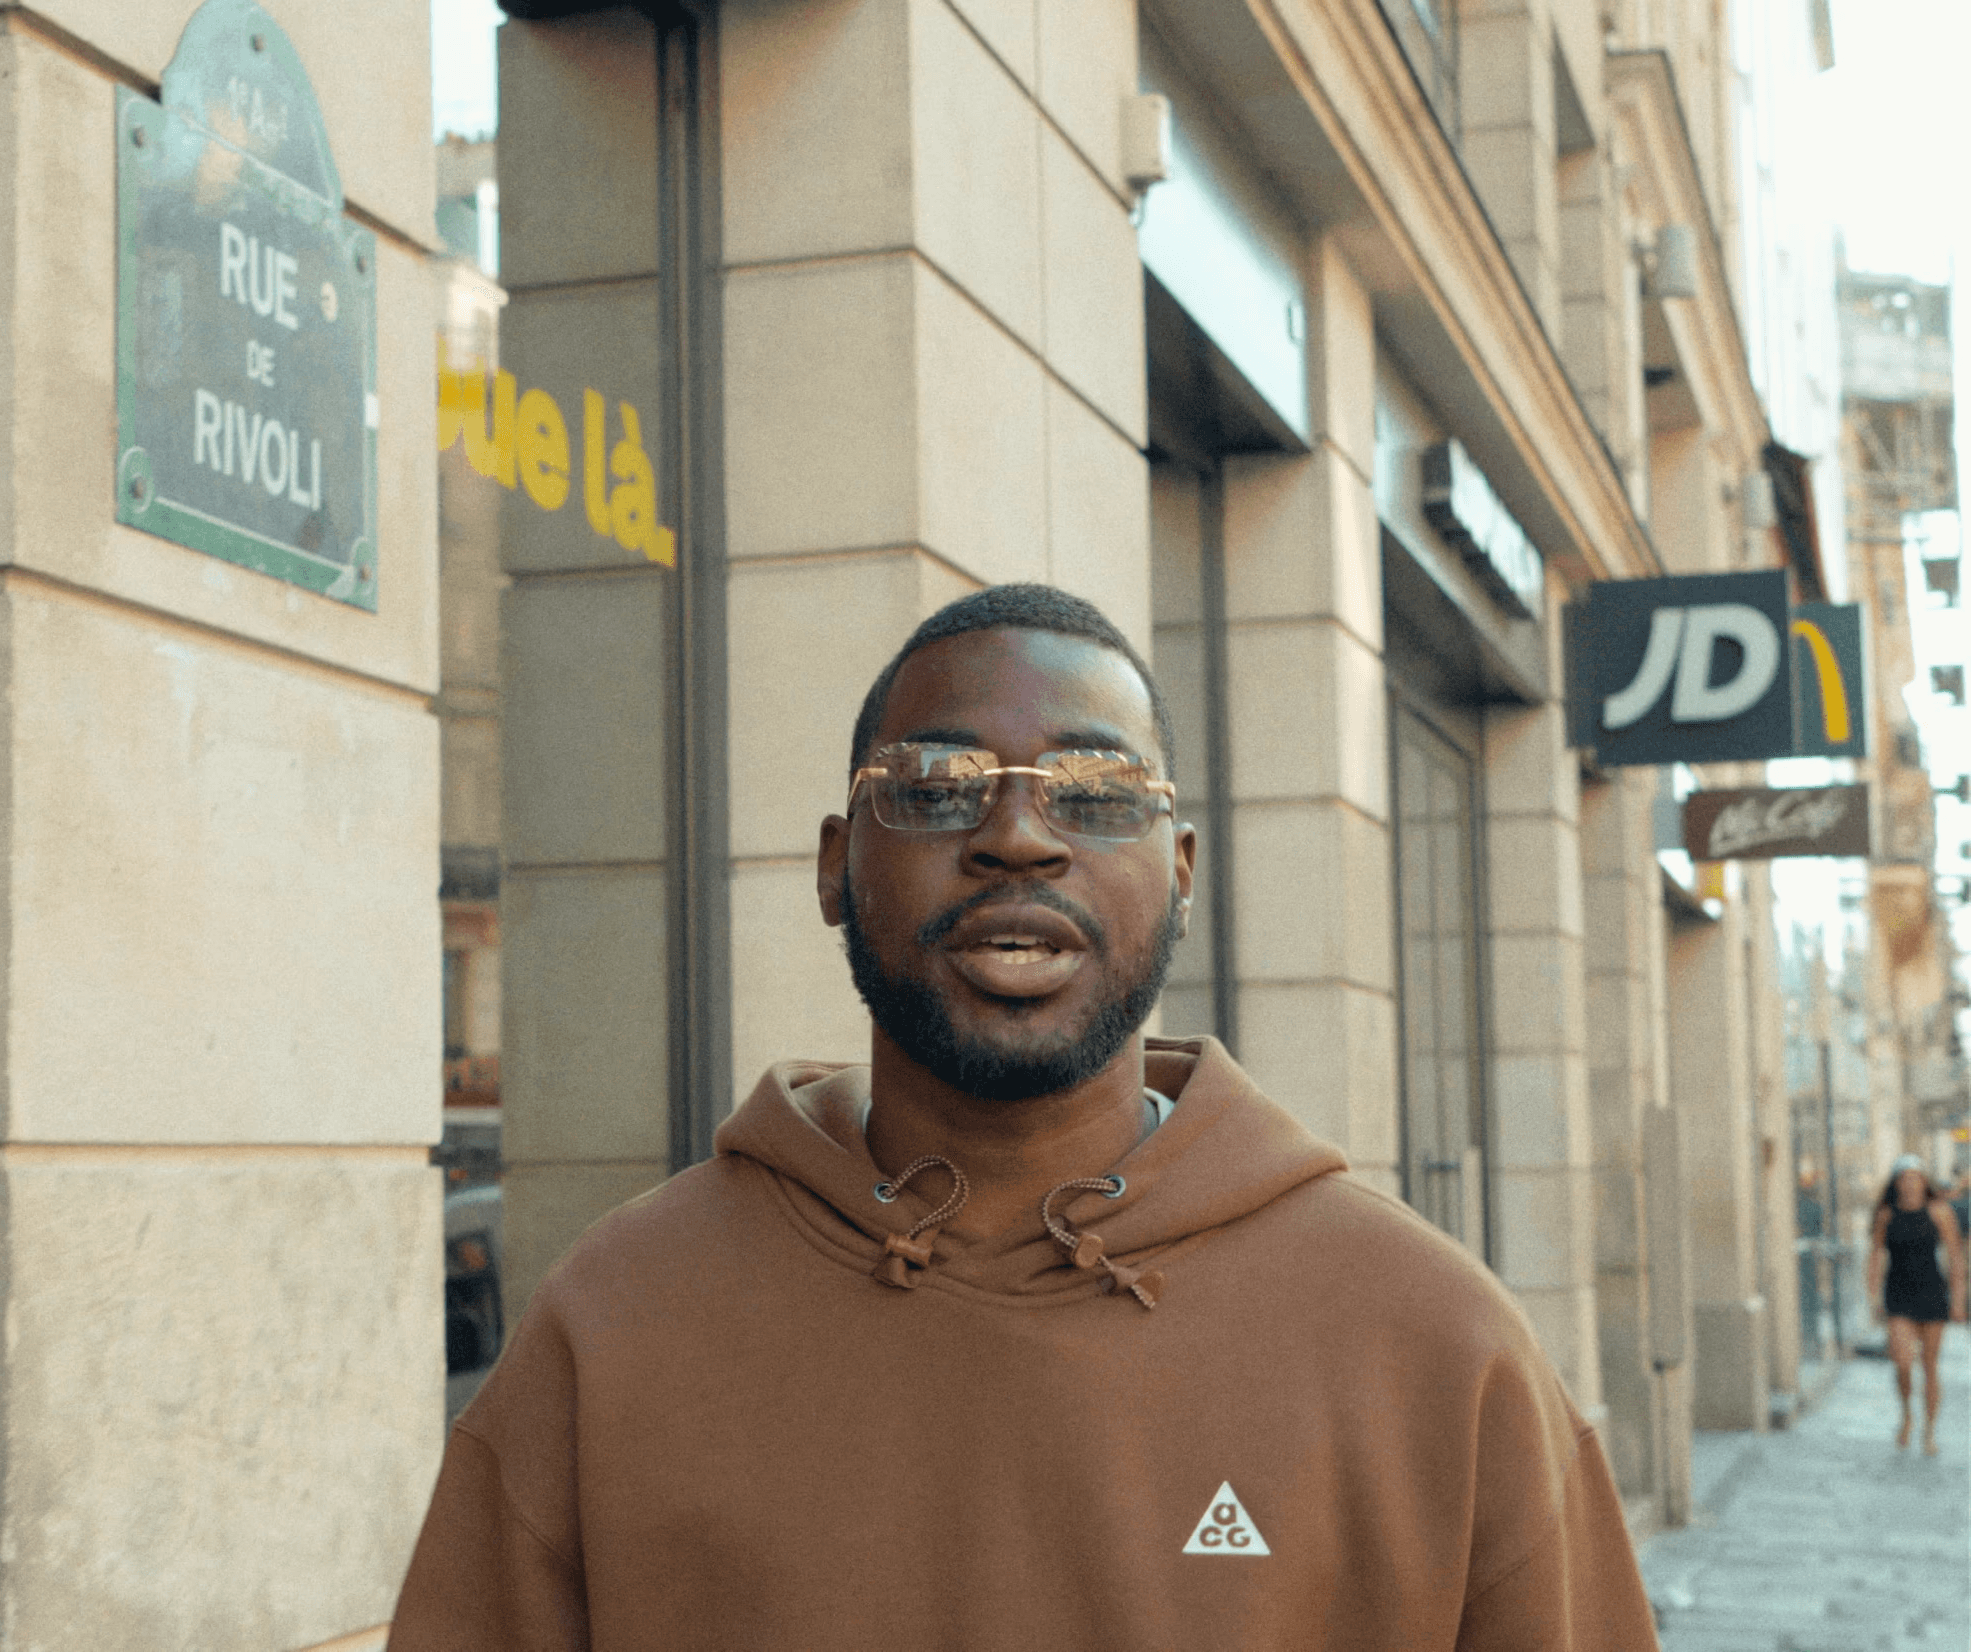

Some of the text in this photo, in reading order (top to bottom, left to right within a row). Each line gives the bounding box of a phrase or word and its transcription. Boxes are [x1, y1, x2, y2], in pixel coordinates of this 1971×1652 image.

[220, 221, 299, 330] RUE
[246, 338, 275, 387] DE
[193, 387, 322, 511] RIVOLI
[1602, 603, 1781, 730] JD
